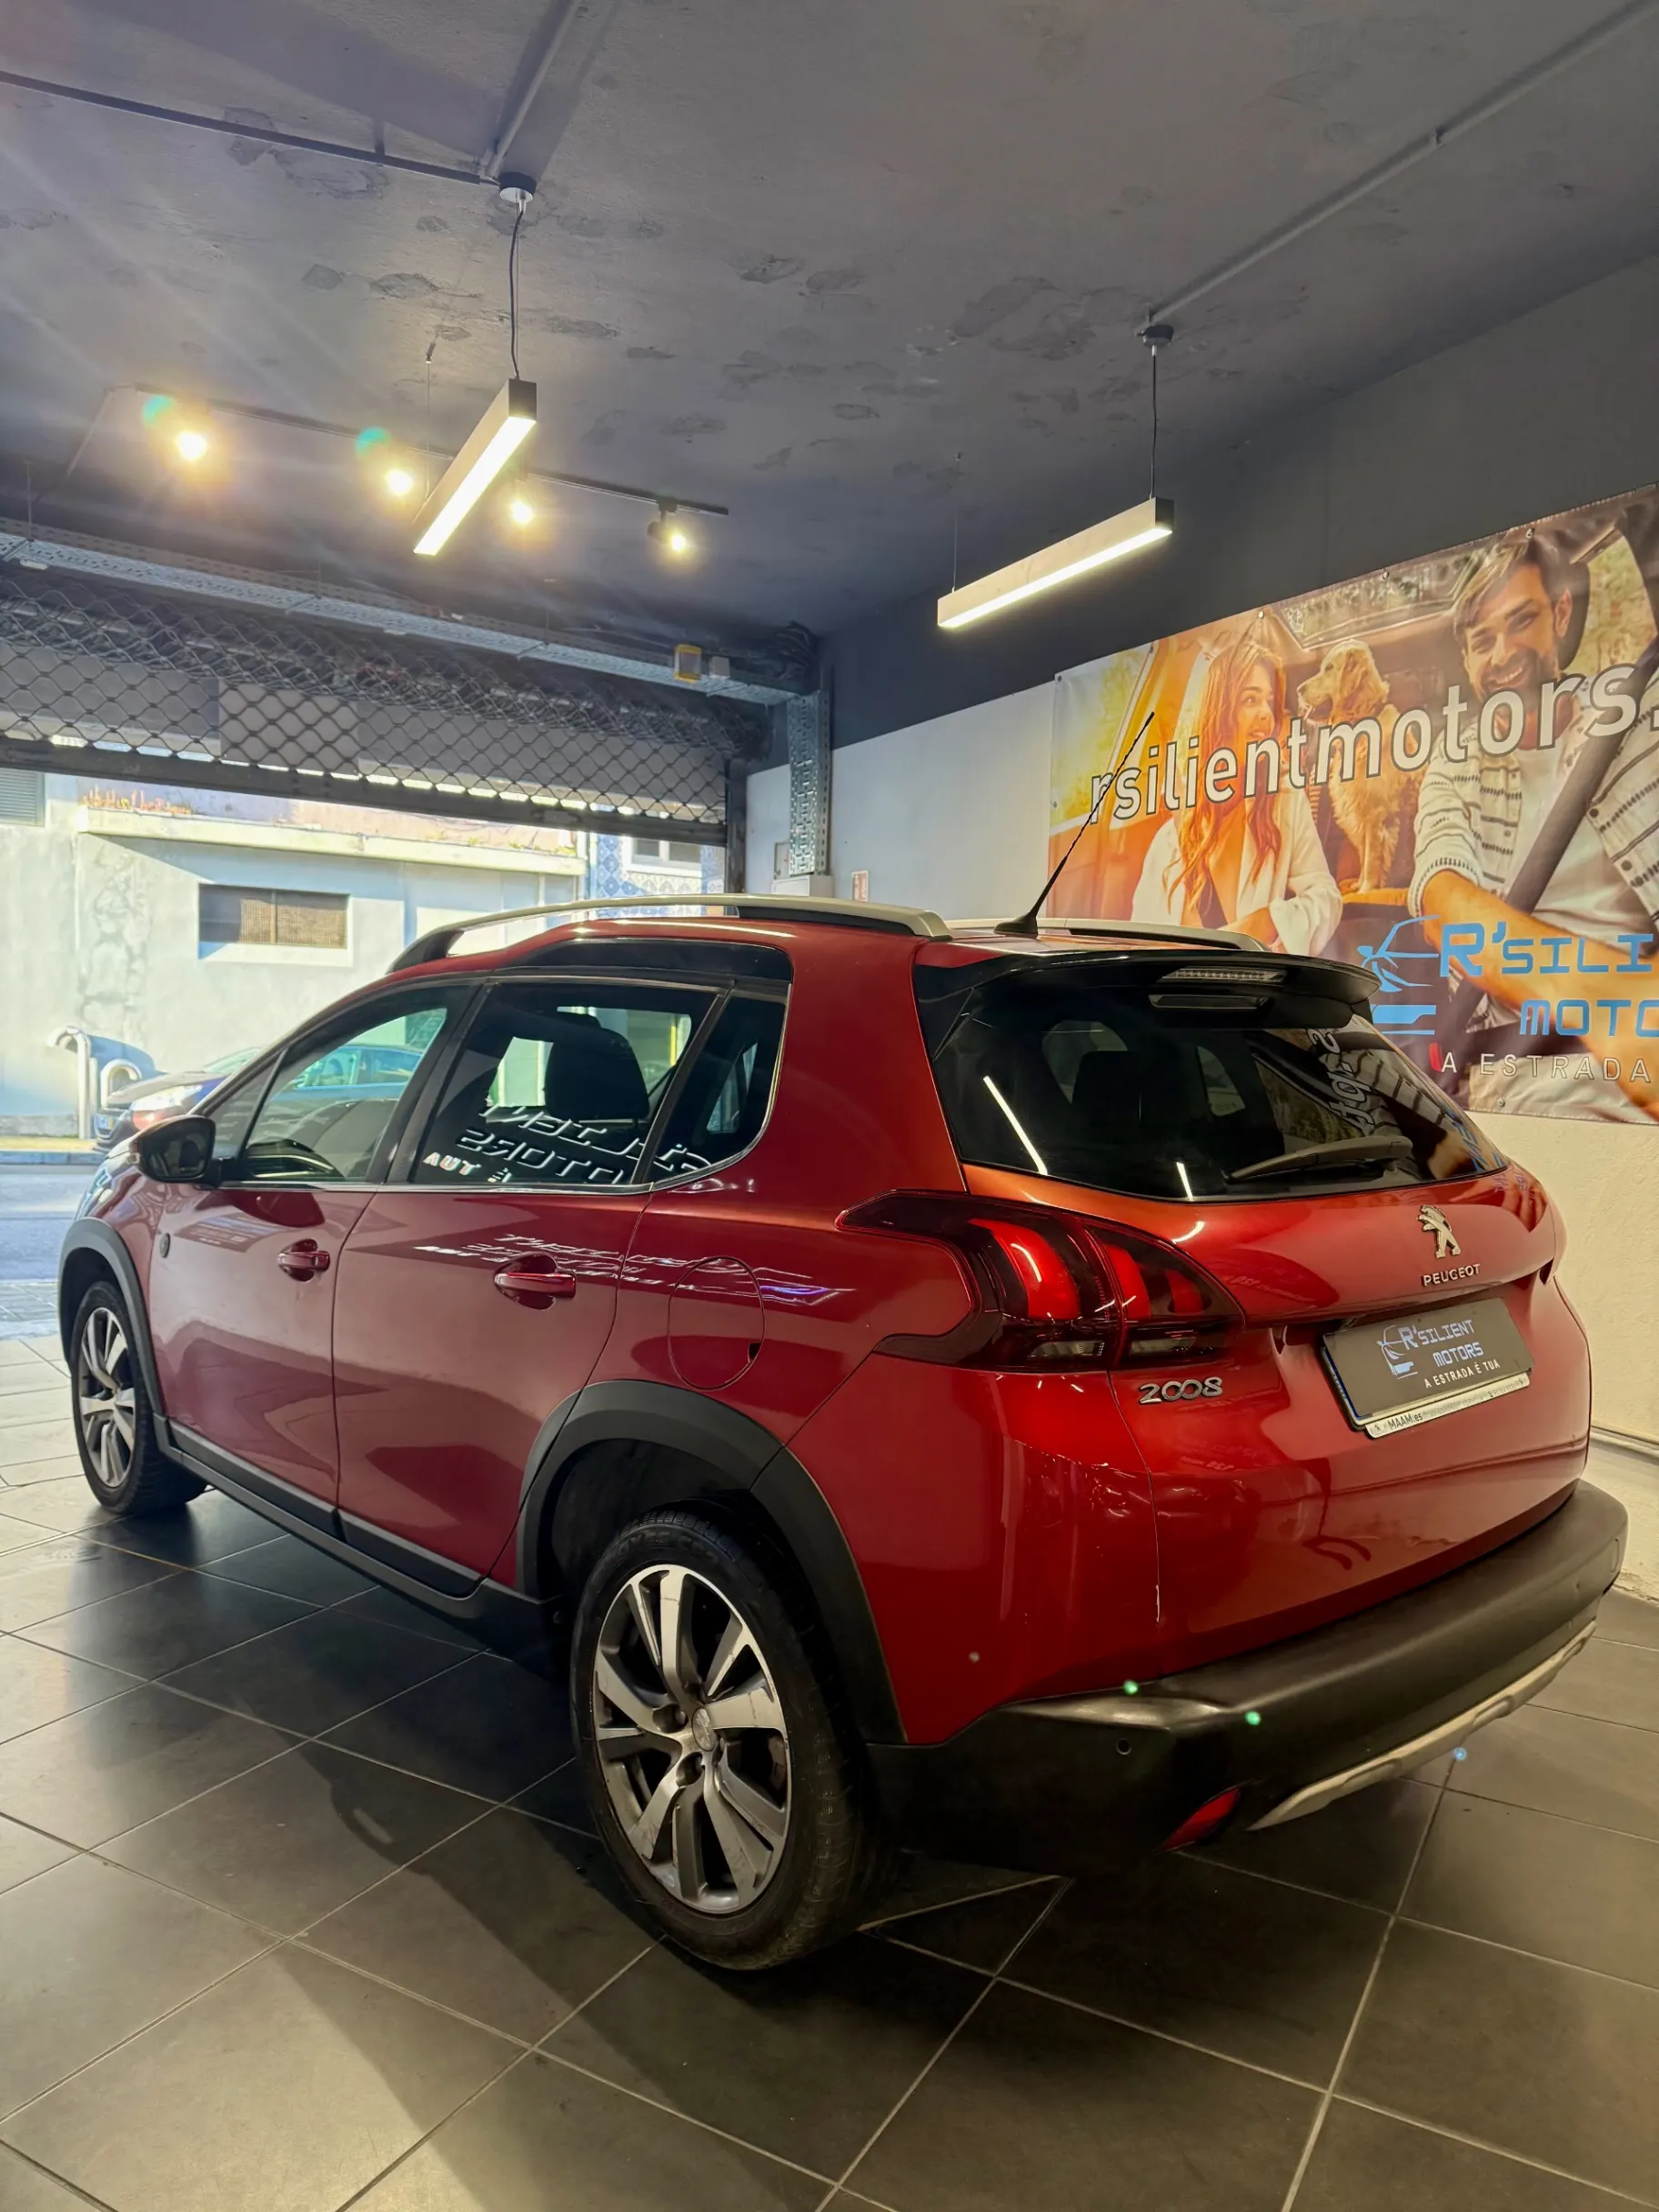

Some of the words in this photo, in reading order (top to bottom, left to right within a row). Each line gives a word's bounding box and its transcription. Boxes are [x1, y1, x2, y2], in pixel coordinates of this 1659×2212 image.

[1442, 1051, 1457, 1073] A
[1480, 1053, 1651, 1083] ESTRADA
[1423, 1263, 1481, 1287] PEUGEOT
[1398, 1319, 1475, 1350] R'SILIENT
[1432, 1342, 1484, 1367] MOTORS
[1423, 1378, 1433, 1389] A
[1433, 1367, 1474, 1386] ESTRADA
[1475, 1363, 1483, 1374] É
[1484, 1359, 1501, 1372] TUA
[1138, 1375, 1223, 1405] 2008
